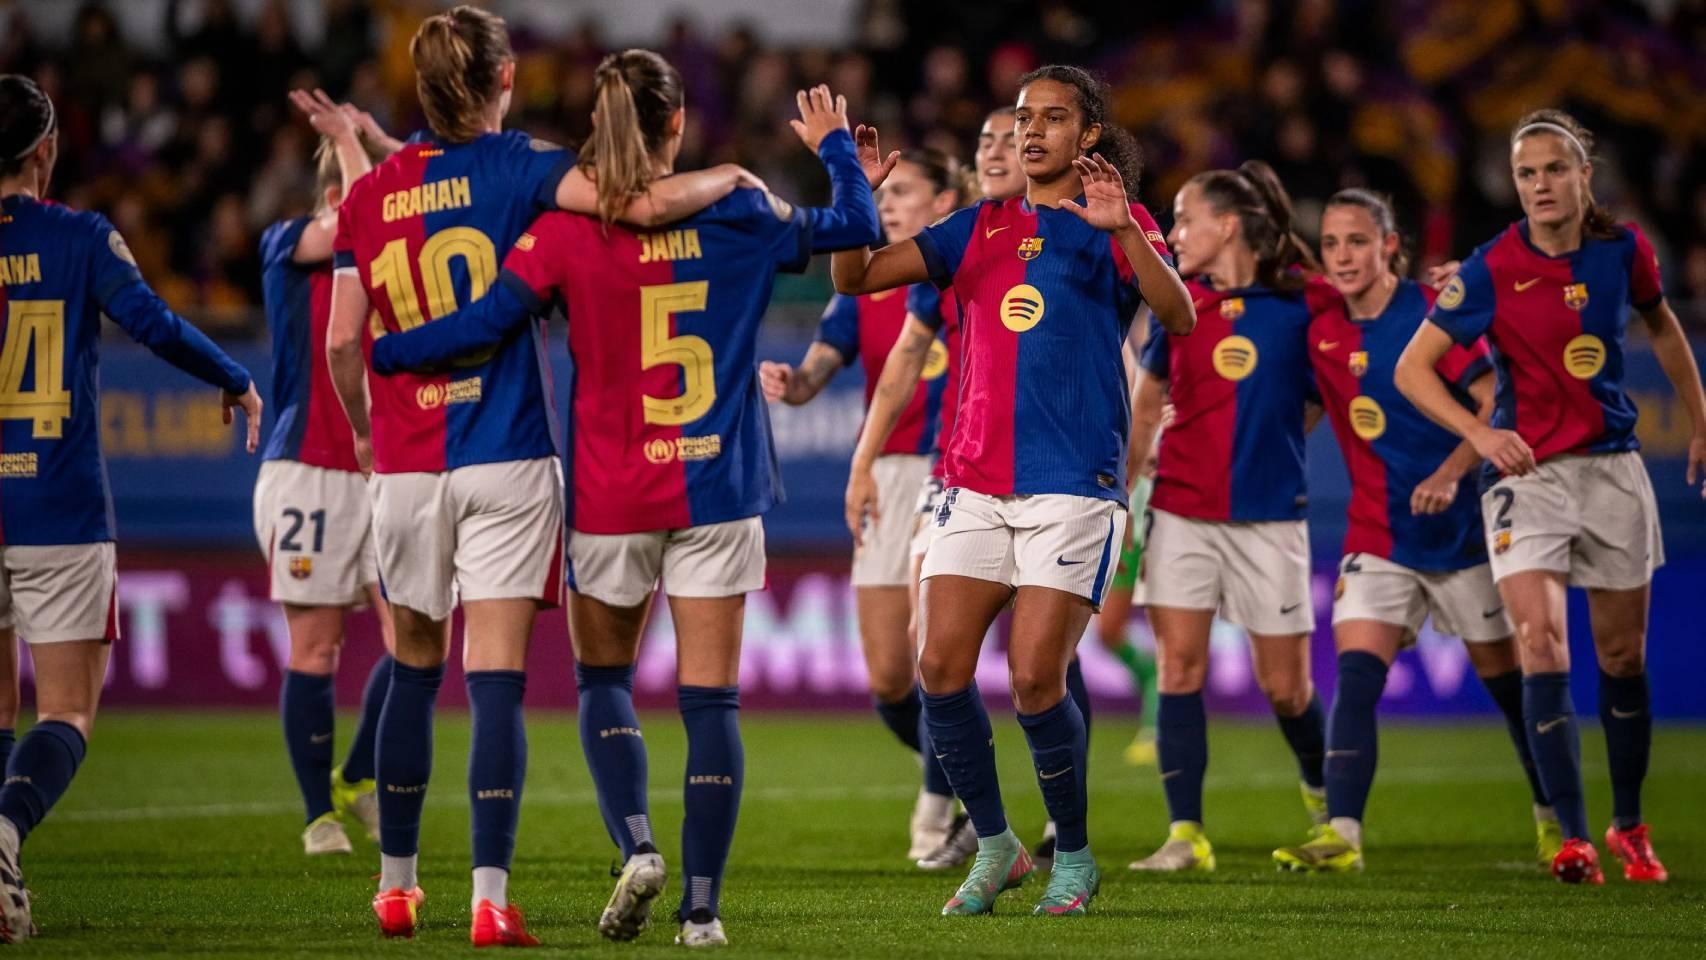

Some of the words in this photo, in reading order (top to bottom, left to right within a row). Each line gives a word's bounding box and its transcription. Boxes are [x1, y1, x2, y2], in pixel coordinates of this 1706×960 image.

[382, 176, 472, 223] GRAHAM
[637, 229, 702, 263] JANA
[369, 226, 498, 366] 10
[639, 280, 717, 427] 5
[279, 507, 327, 553] 21
[1493, 486, 1516, 529] 2
